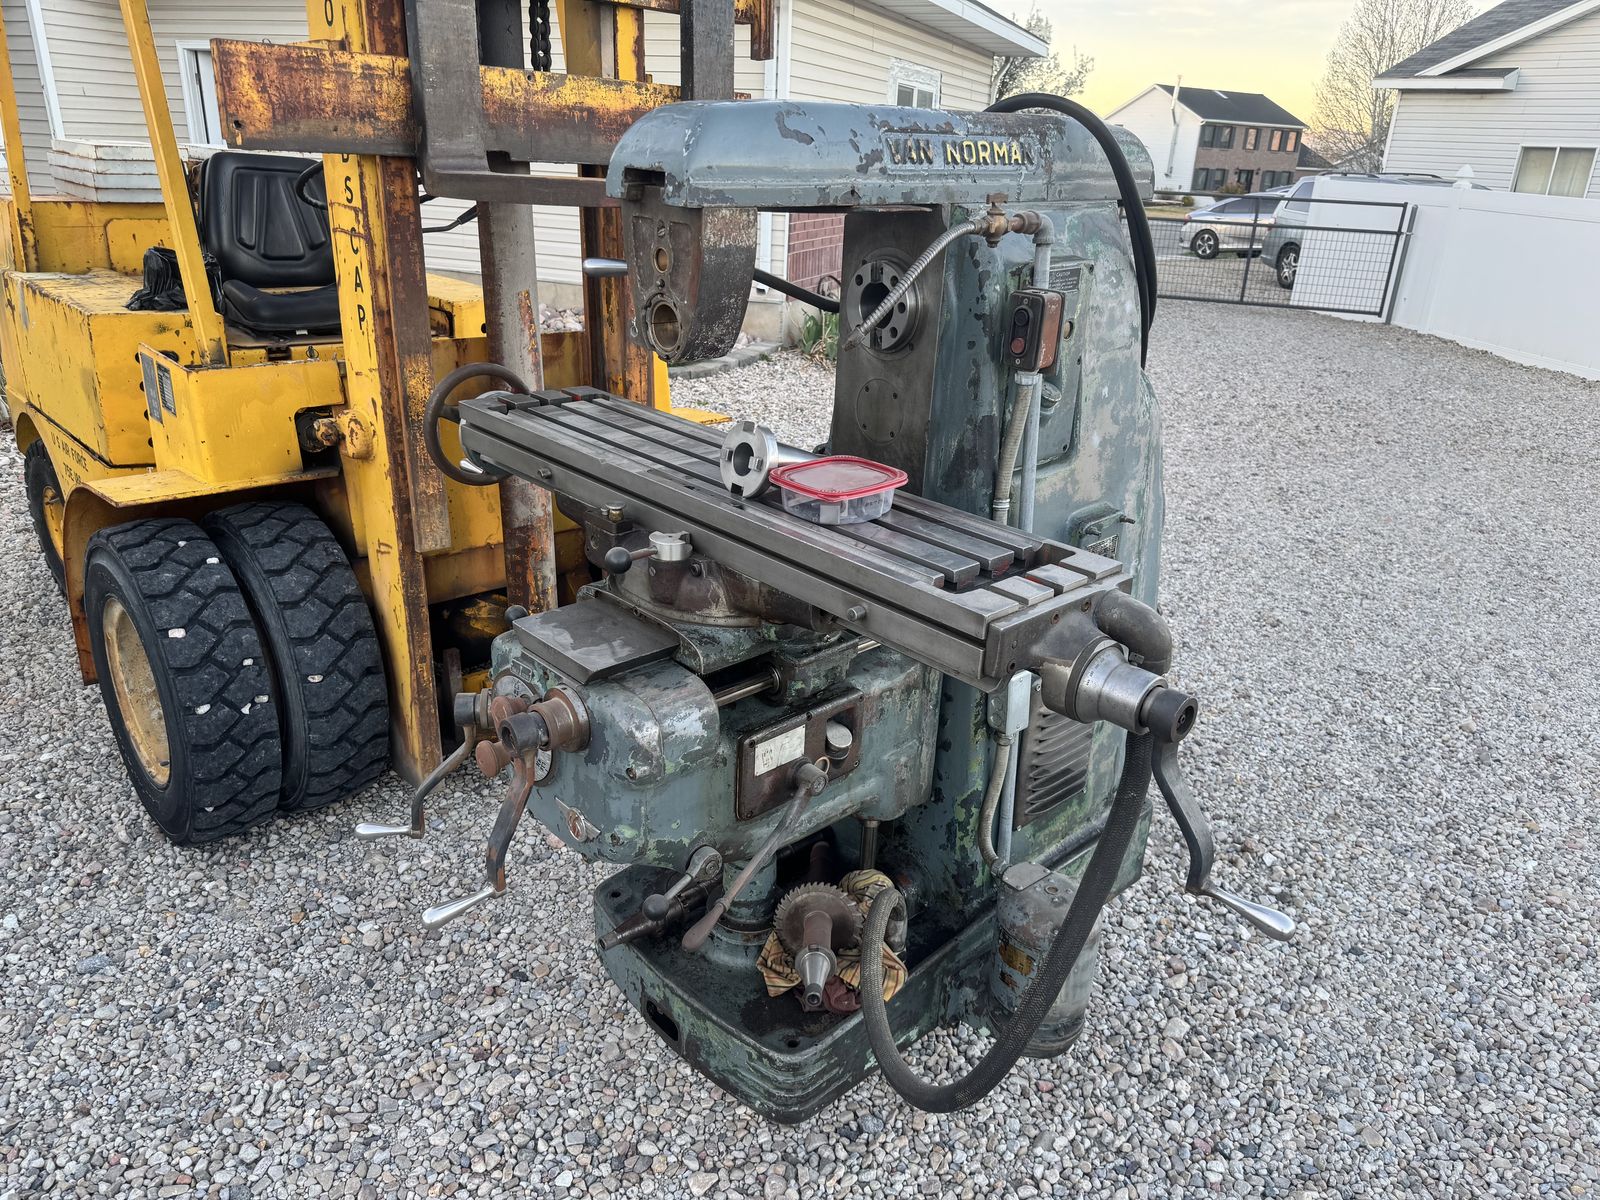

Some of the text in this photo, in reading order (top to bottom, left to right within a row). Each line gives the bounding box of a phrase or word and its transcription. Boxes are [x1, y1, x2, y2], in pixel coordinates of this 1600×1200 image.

[885, 138, 1035, 166] VAN NORMAN
[62, 440, 70, 457] AIR
[70, 447, 88, 472] FORCE
